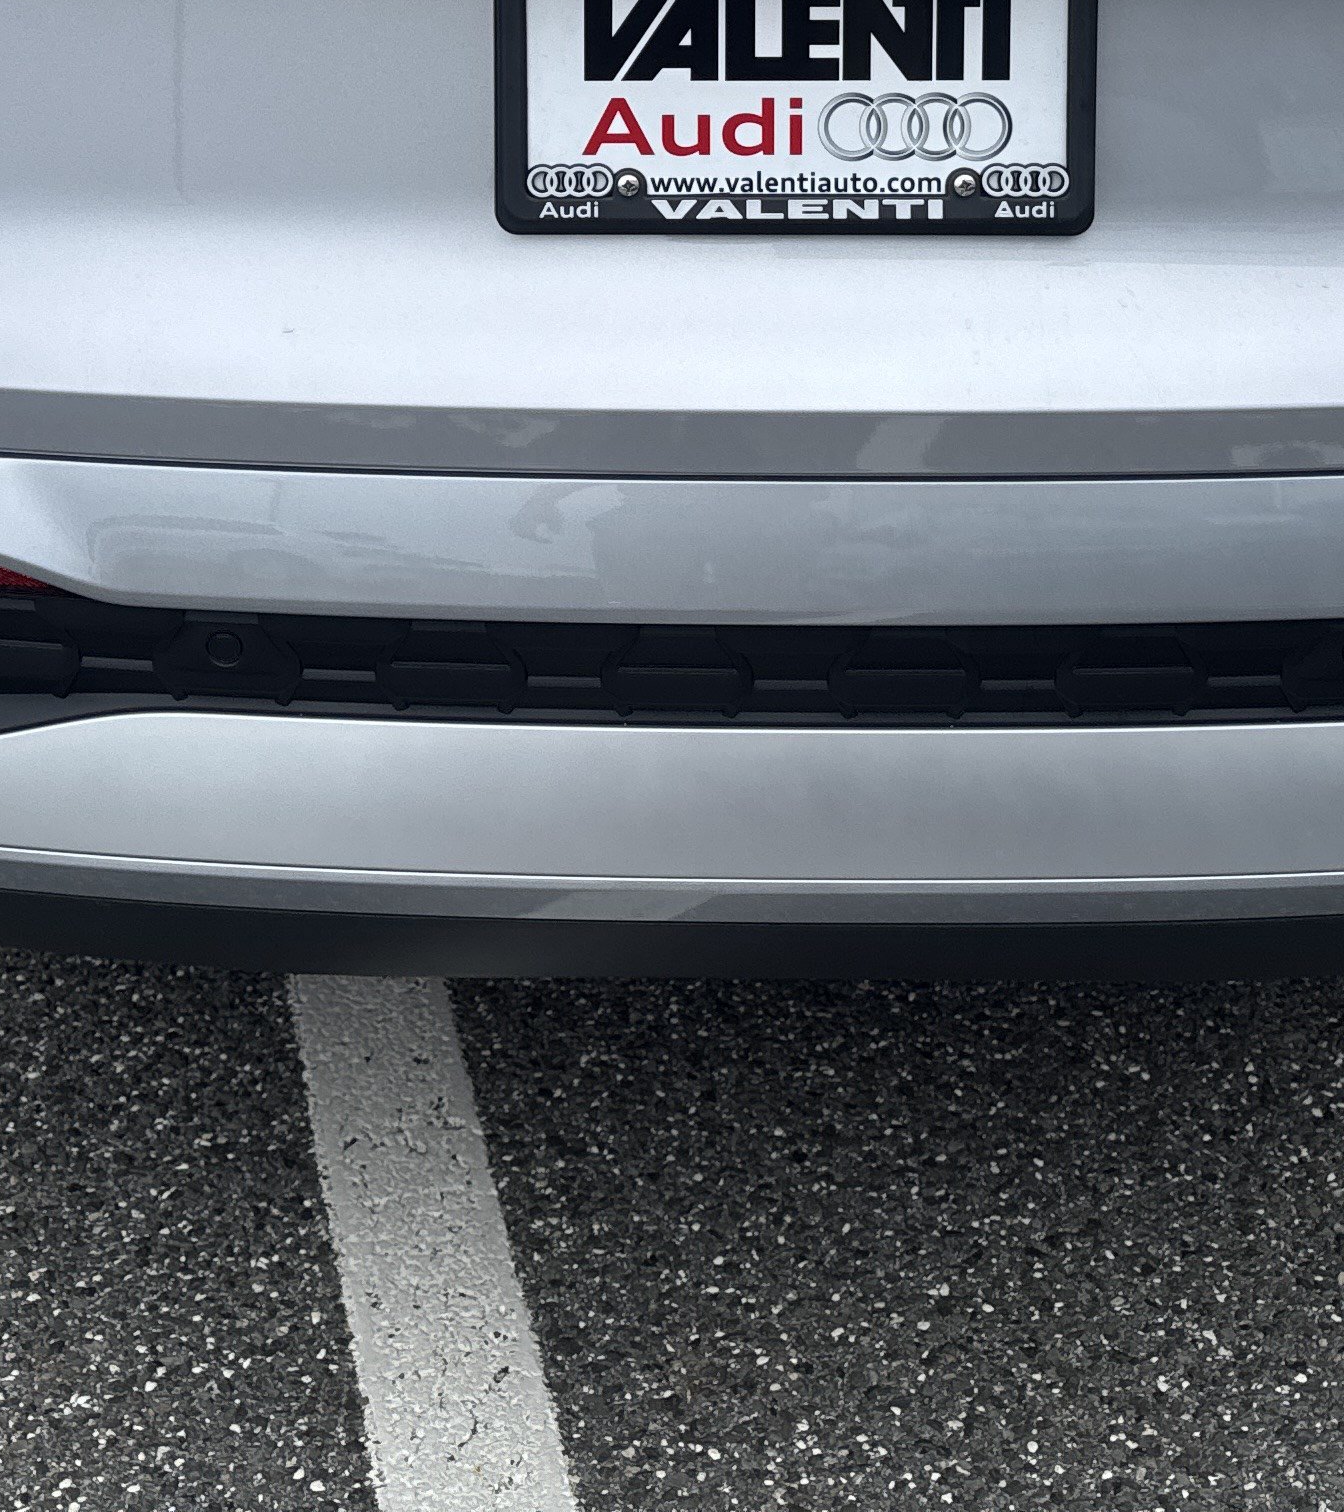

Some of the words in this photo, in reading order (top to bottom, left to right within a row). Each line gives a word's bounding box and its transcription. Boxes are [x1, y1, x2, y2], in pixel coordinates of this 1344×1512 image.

[582, 97, 805, 156] Audi
[650, 170, 943, 194] www.valentiauto.com
[539, 201, 600, 219] Audi
[651, 199, 944, 220] VALENTI
[994, 200, 1056, 219] Audi
